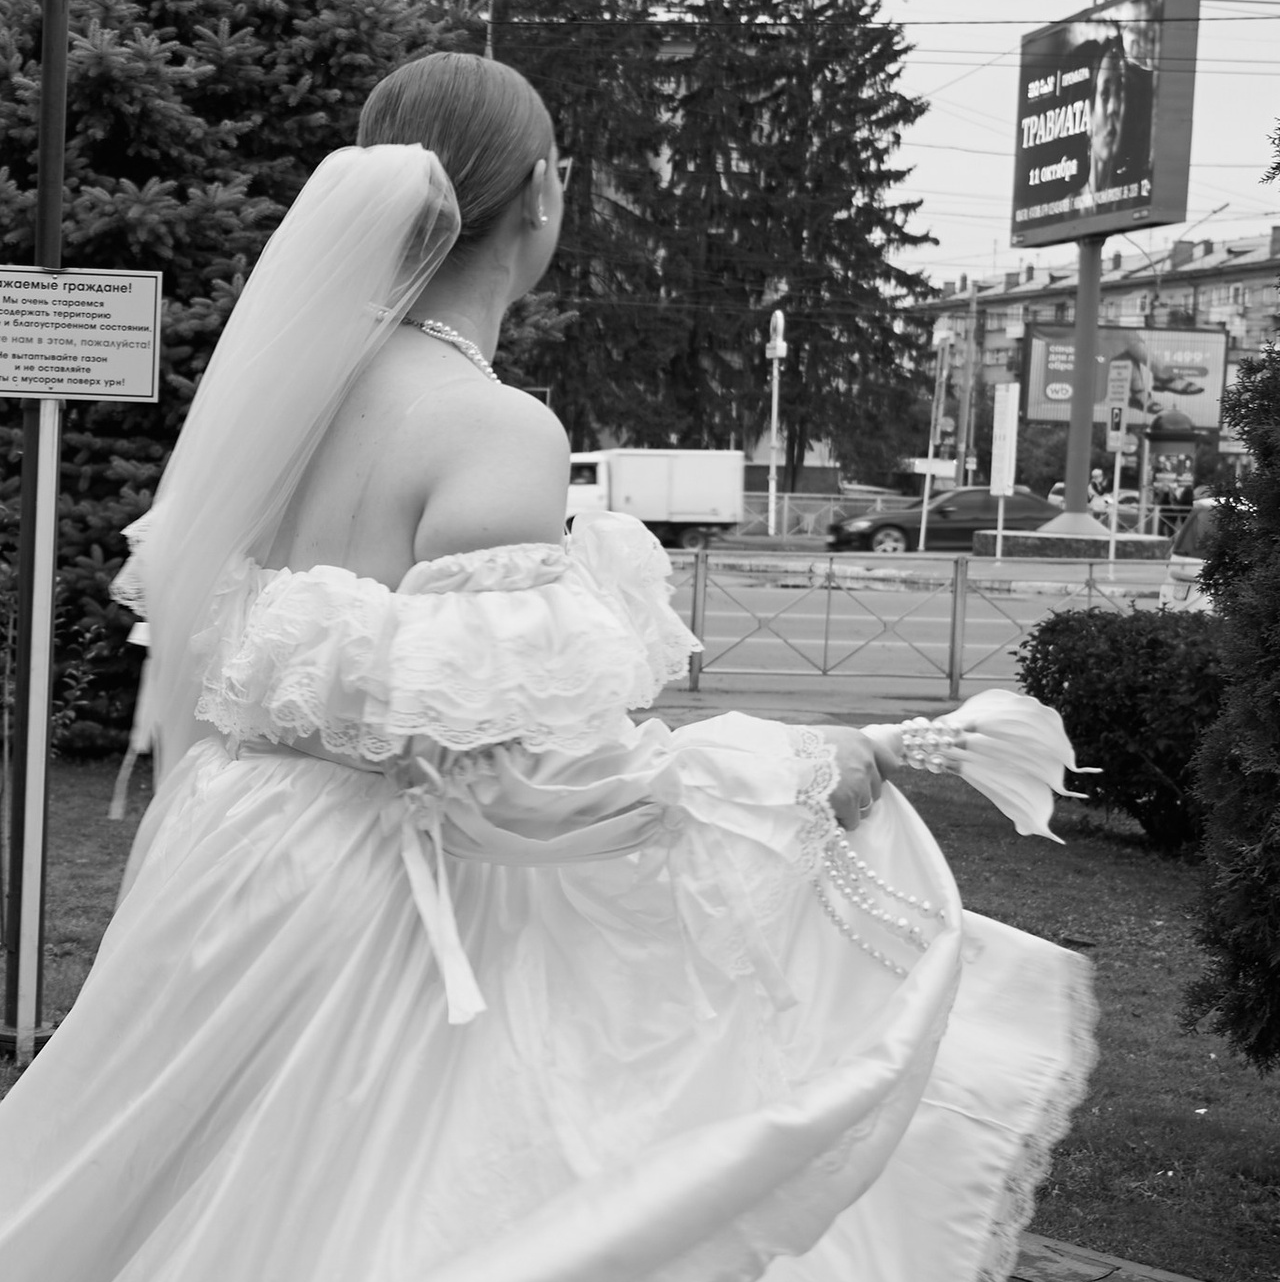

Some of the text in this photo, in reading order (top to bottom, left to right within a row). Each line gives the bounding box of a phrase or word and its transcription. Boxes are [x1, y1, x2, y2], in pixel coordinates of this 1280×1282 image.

[1021, 99, 1091, 148] ТРАВИАТА
[1029, 156, 1078, 185] 11 октября
[62, 281, 132, 294] граждане!
[2, 295, 105, 308] Мы очень стараемся
[52, 310, 112, 321] территорию
[12, 318, 97, 330] благоустроенном
[99, 325, 153, 334] состоянии.
[11, 336, 34, 344] нам
[47, 337, 77, 347] этом,
[80, 339, 151, 350] пожалуйста!
[11, 353, 79, 362] вытаптывайте
[37, 365, 92, 374] оставляйте
[20, 376, 64, 386] мусором
[66, 378, 101, 387] поверх
[103, 378, 125, 388] урн!
